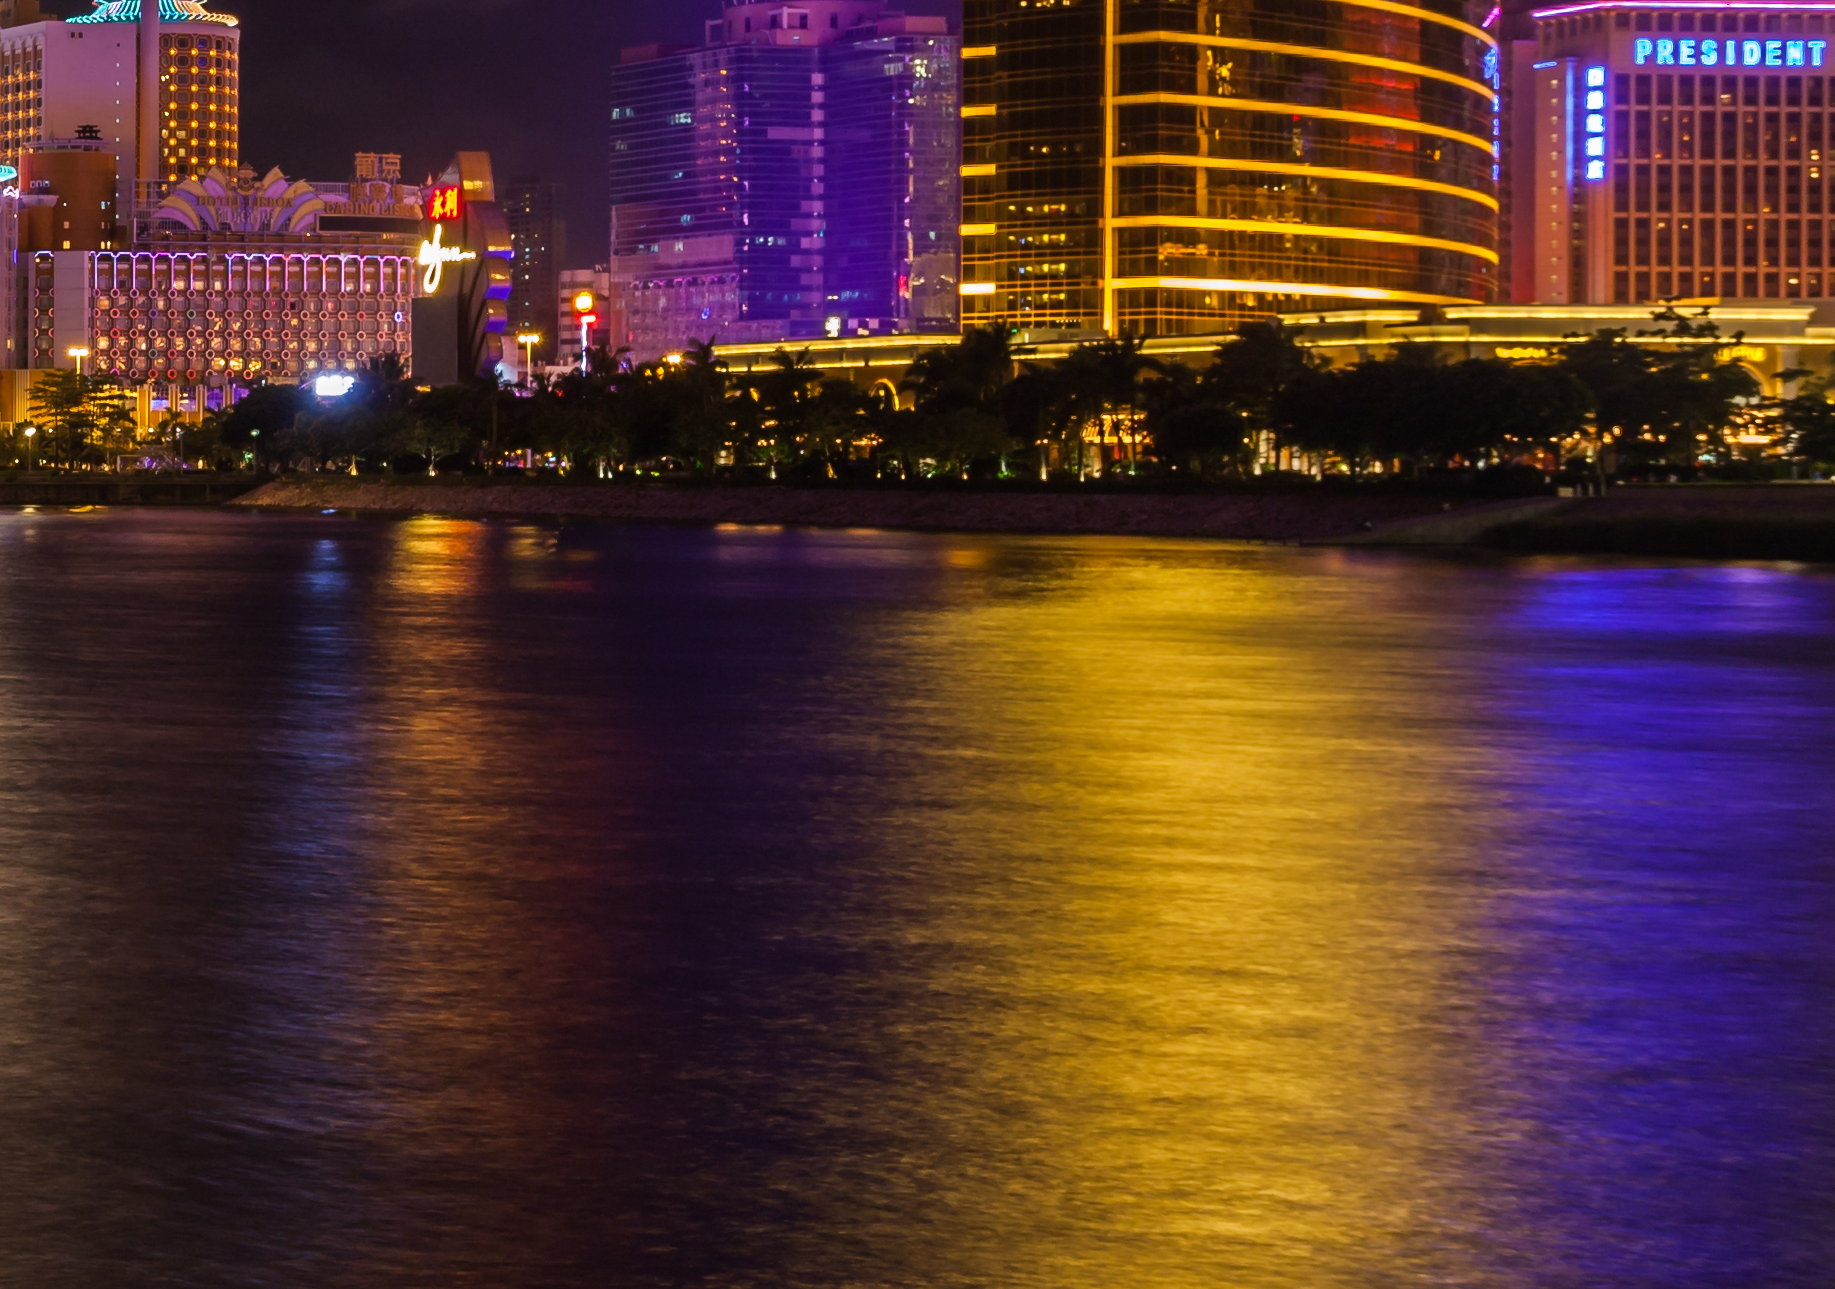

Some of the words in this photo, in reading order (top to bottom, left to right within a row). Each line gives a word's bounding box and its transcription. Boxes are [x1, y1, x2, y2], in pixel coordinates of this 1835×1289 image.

[1635, 37, 1826, 66] PRESIDENT
[325, 201, 376, 215] CASINO
[430, 186, 460, 220] 永利
